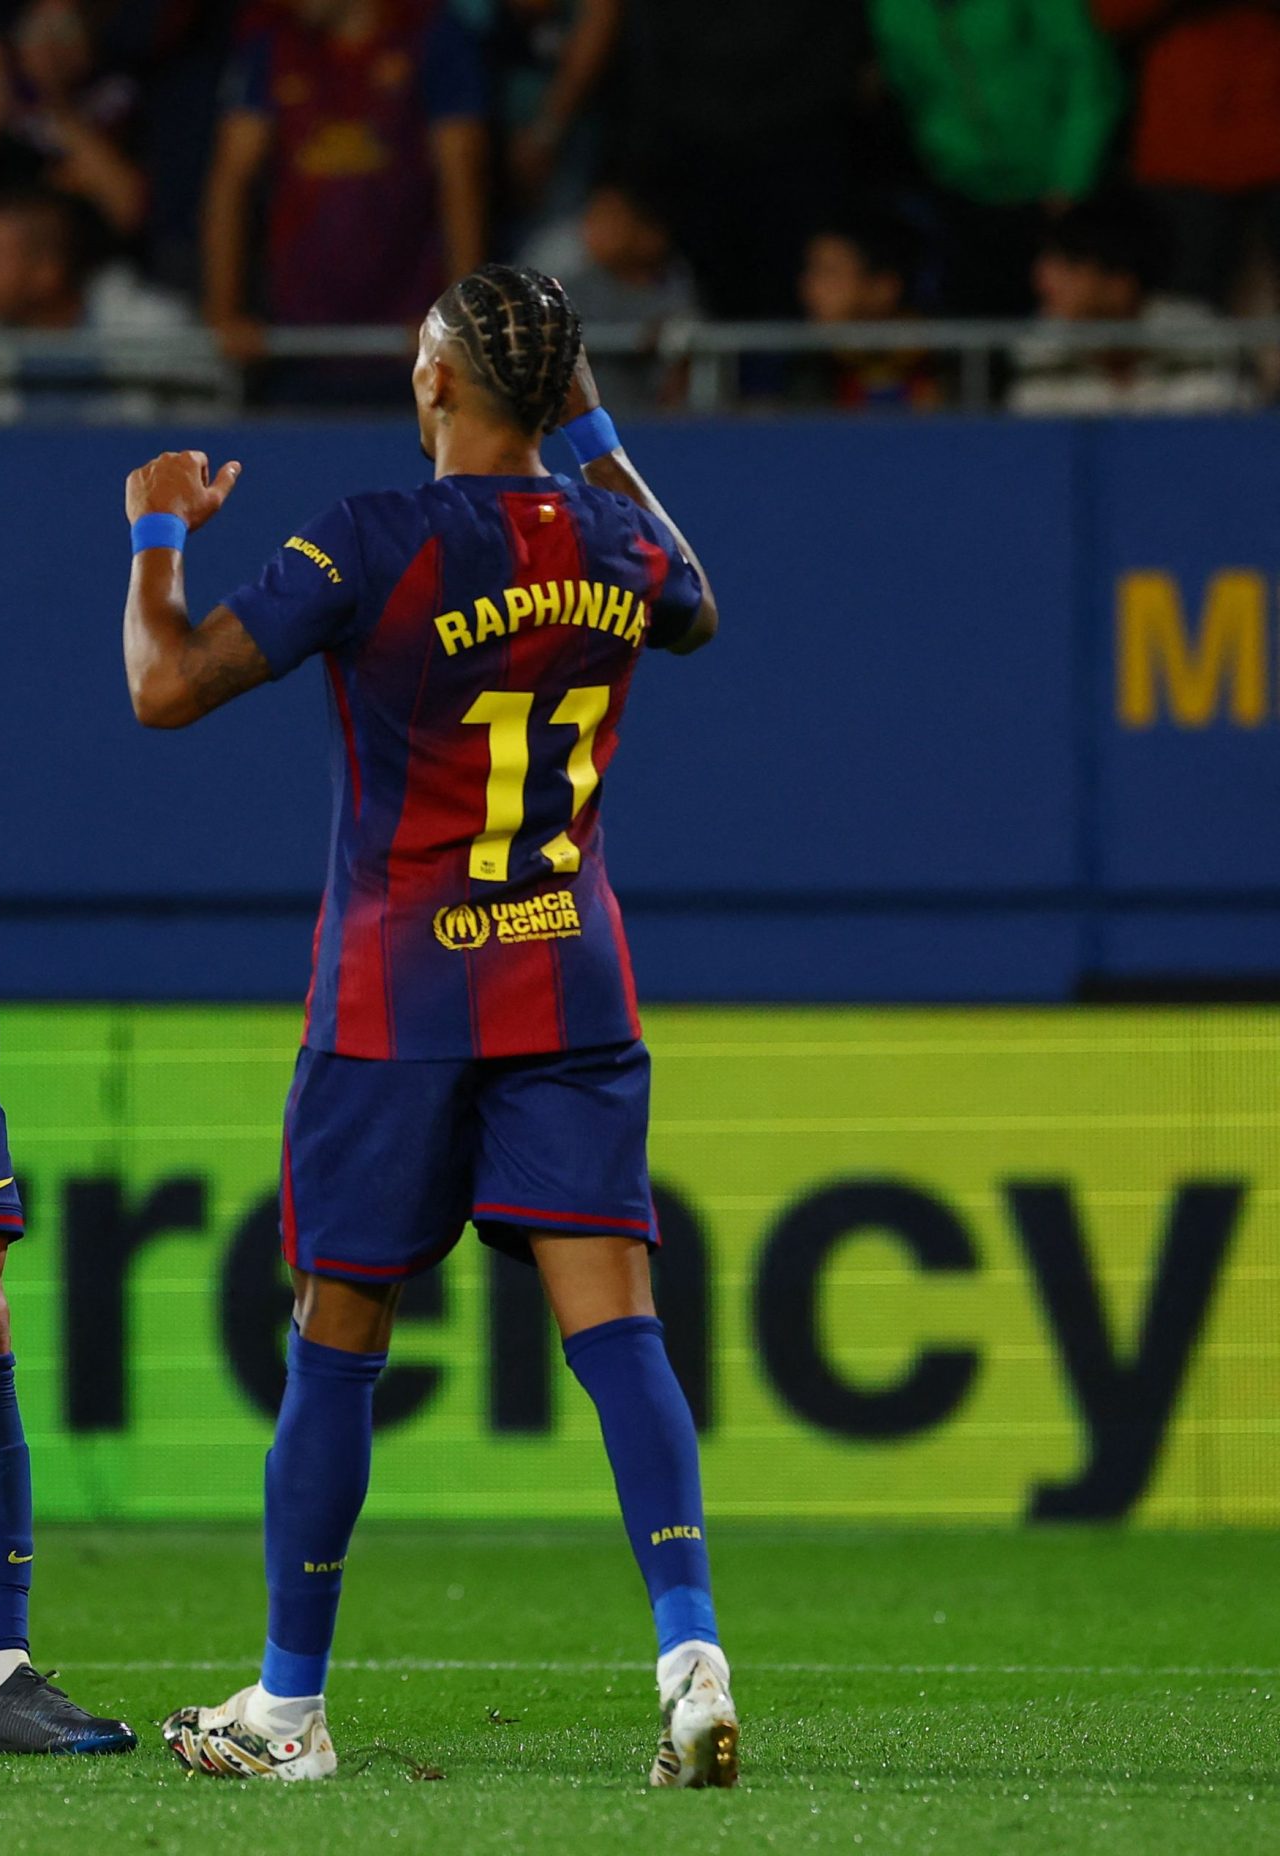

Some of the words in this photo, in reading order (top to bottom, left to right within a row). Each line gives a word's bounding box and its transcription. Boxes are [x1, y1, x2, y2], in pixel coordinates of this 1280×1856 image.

[461, 685, 610, 881] 11
[491, 890, 575, 921] UNHCR
[497, 909, 581, 937] ACNUR
